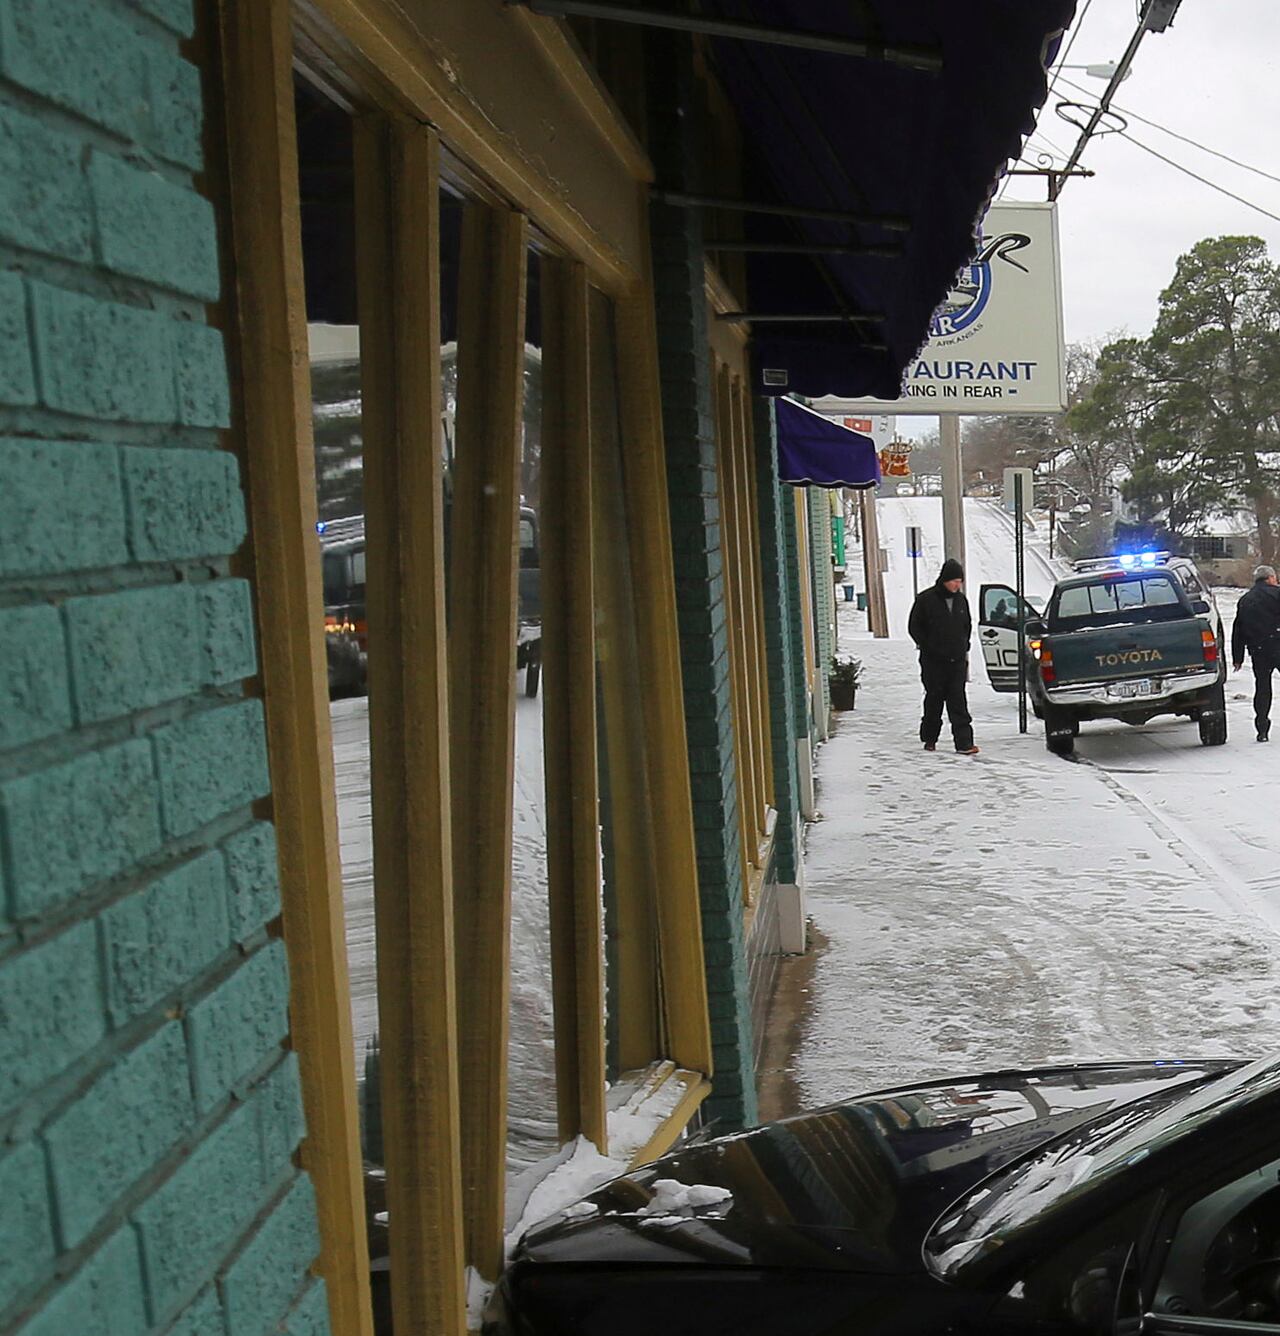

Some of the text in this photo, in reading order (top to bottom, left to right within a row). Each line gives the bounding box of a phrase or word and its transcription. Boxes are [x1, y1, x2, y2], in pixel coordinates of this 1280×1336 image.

[936, 322, 984, 347] ARKANSAS
[943, 385, 957, 397] IN
[963, 386, 1003, 397] REAR
[1096, 649, 1163, 667] TOYOTA
